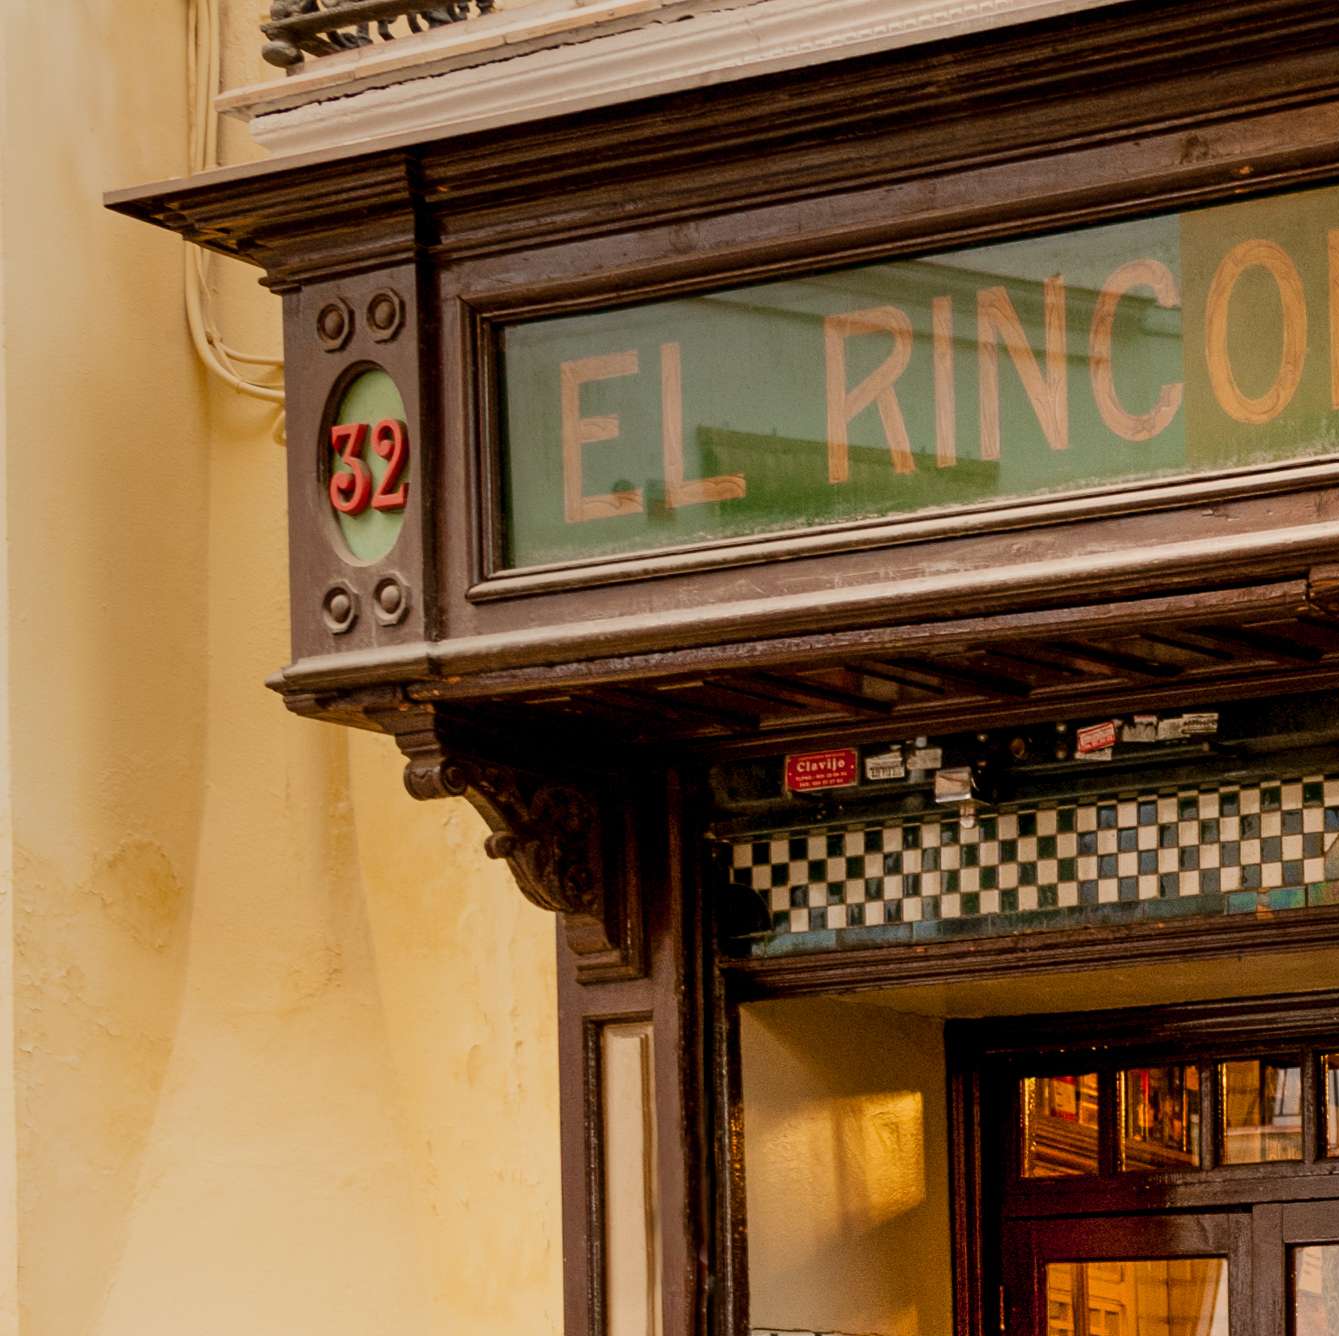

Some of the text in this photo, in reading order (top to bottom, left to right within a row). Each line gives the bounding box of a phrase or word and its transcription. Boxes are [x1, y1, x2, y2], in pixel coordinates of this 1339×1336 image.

[329, 418, 410, 516] 32
[560, 341, 747, 524] EL
[796, 757, 846, 773] Clavijo
